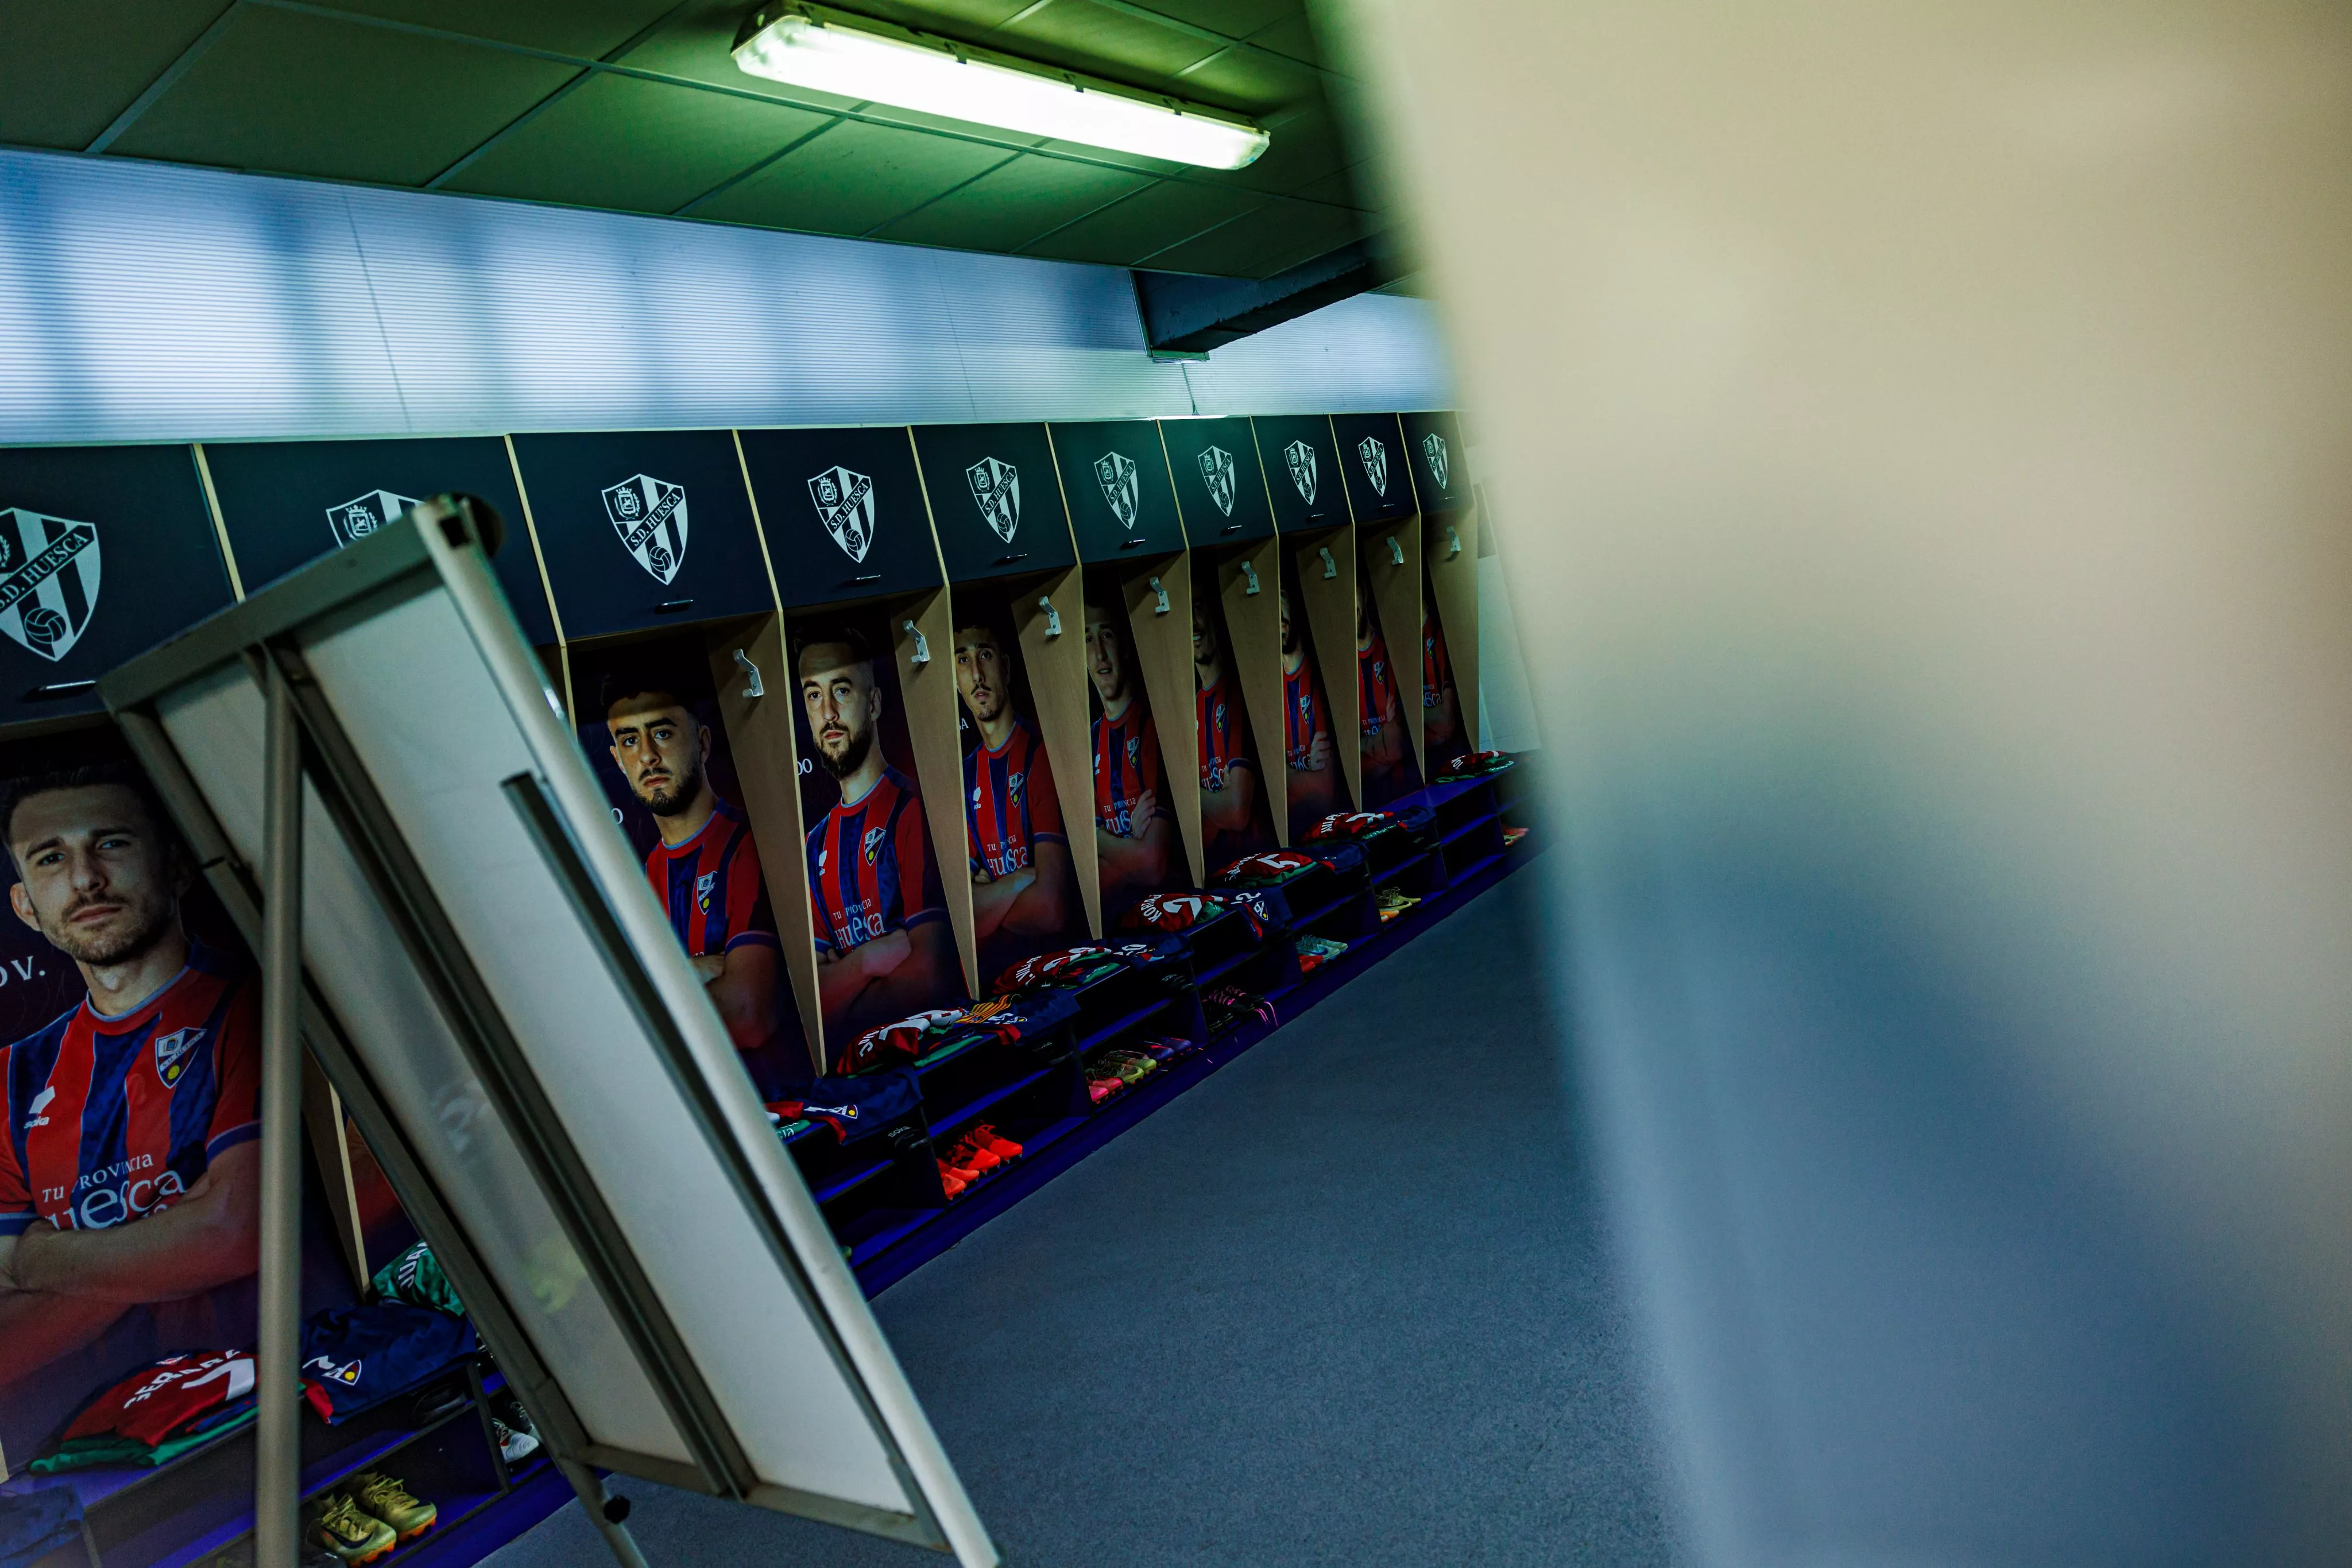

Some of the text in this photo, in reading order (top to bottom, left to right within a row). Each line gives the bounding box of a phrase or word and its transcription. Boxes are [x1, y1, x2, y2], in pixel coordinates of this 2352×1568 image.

[984, 471, 1015, 513] S.D. HUESCA
[1116, 465, 1134, 491] HUESCA
[630, 492, 681, 547] S.D. HUESCA
[830, 482, 869, 529] S.D. HUESCA
[20, 532, 90, 585] HUESCA
[42, 1186, 64, 1203] TU
